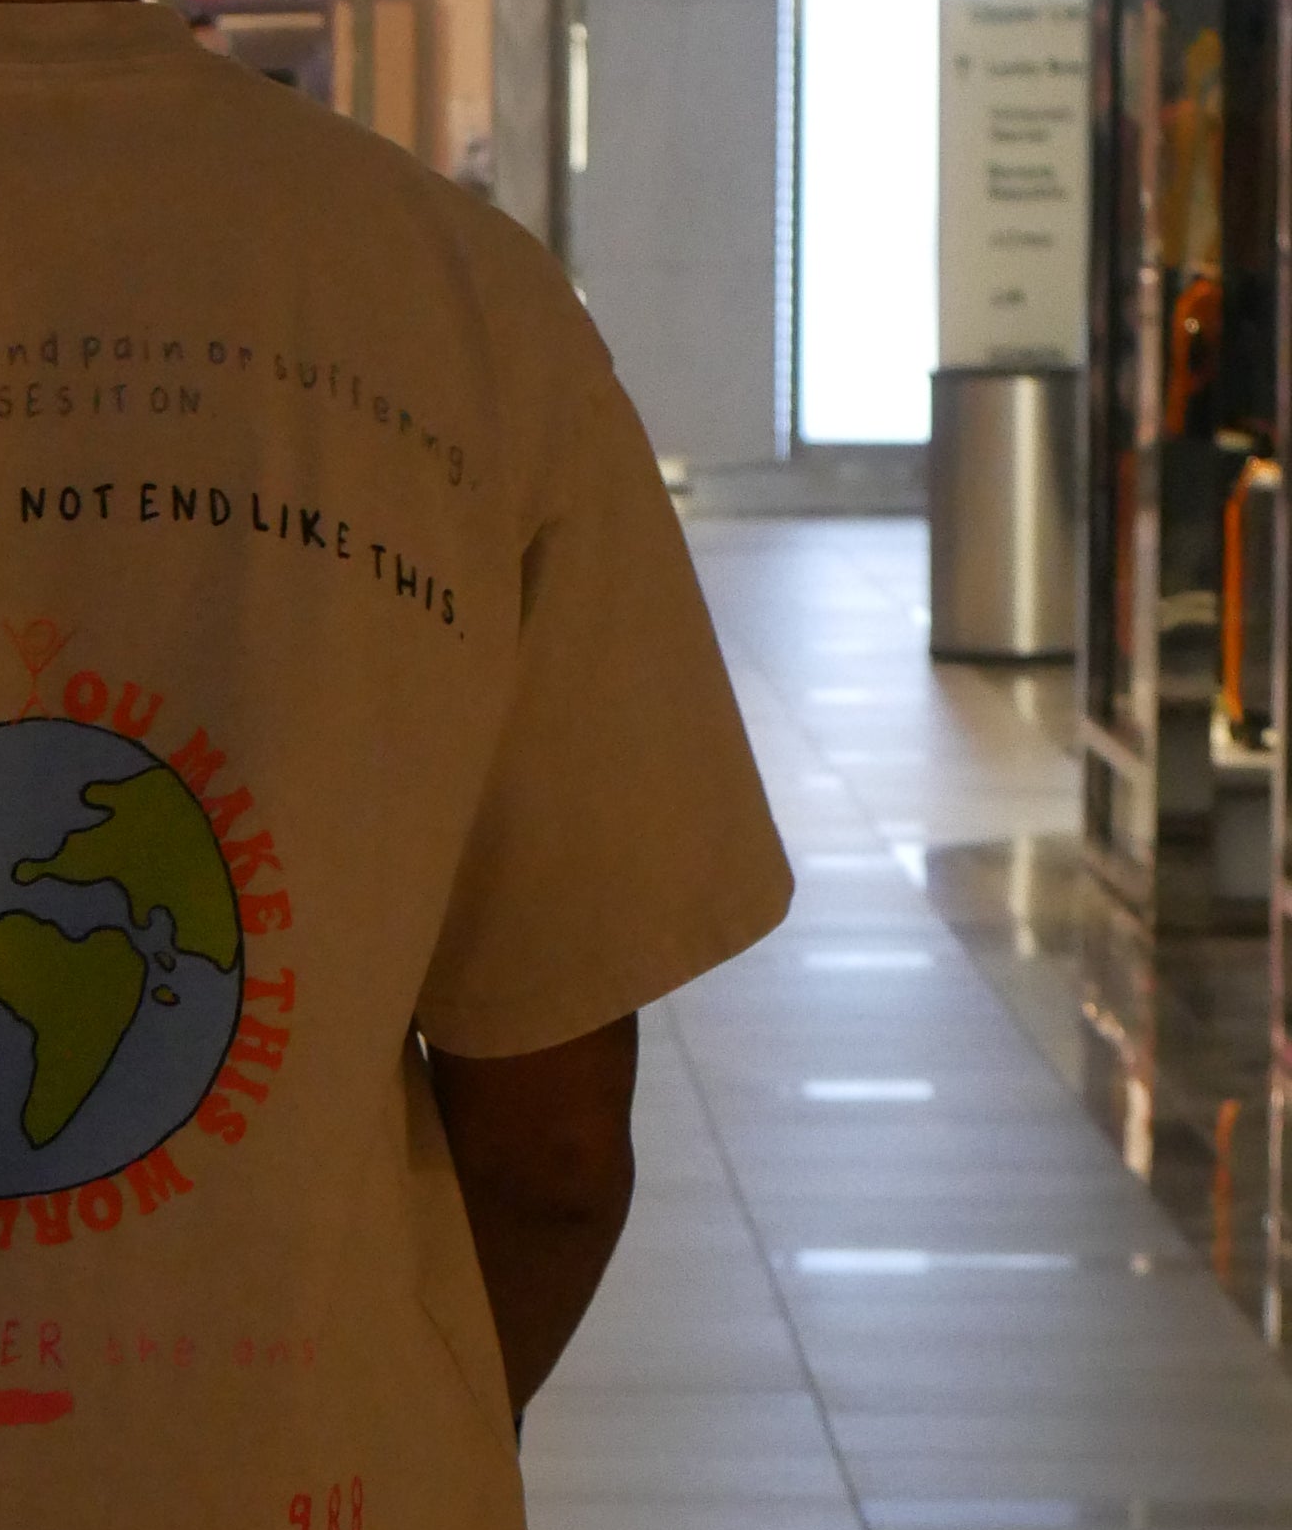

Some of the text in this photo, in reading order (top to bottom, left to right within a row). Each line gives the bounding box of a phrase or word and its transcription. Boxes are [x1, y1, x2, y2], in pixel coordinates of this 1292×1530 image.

[81, 335, 183, 369] pain
[208, 340, 253, 367] or
[19, 483, 114, 524] NOT
[139, 482, 232, 527] END
[251, 492, 351, 560] LIKE
[168, 727, 293, 937] MAKE
[195, 967, 296, 1147] THIS
